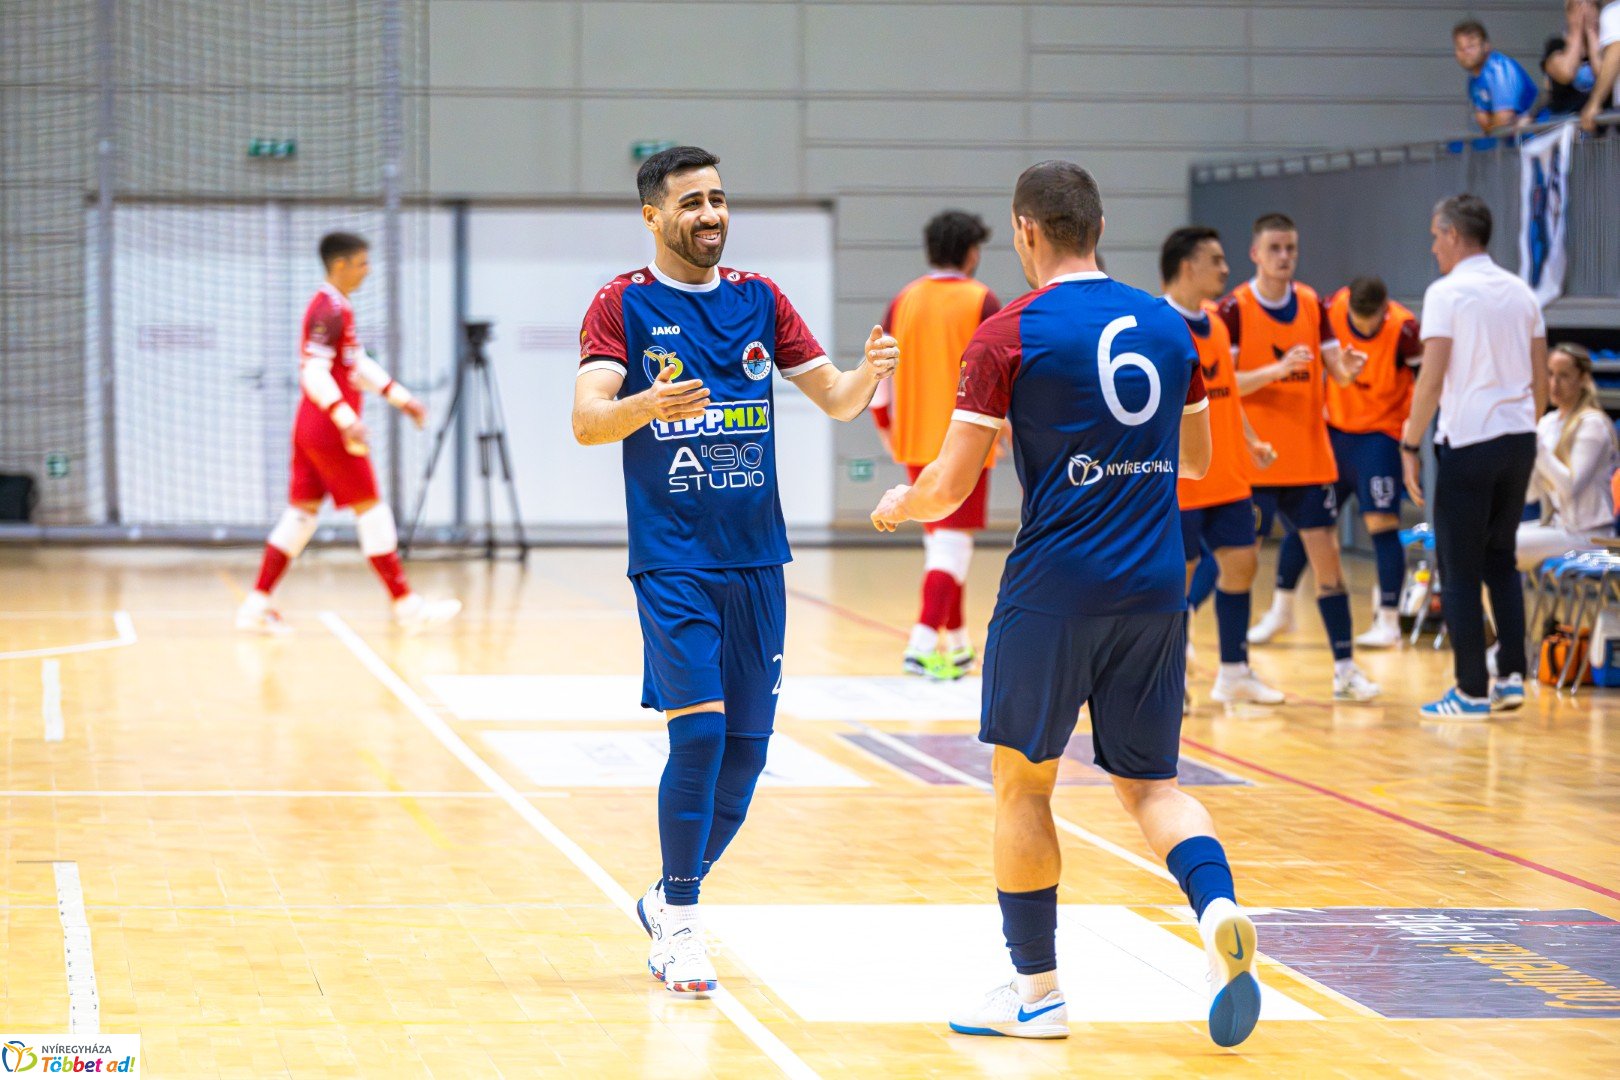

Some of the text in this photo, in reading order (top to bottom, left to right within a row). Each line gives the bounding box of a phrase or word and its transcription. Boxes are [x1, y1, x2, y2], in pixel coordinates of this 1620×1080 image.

[651, 325, 681, 336] JAKO
[1097, 315, 1162, 426] 6
[656, 406, 767, 434] TIPPMIX
[668, 442, 764, 475] A'90
[668, 470, 765, 493] STUDIO
